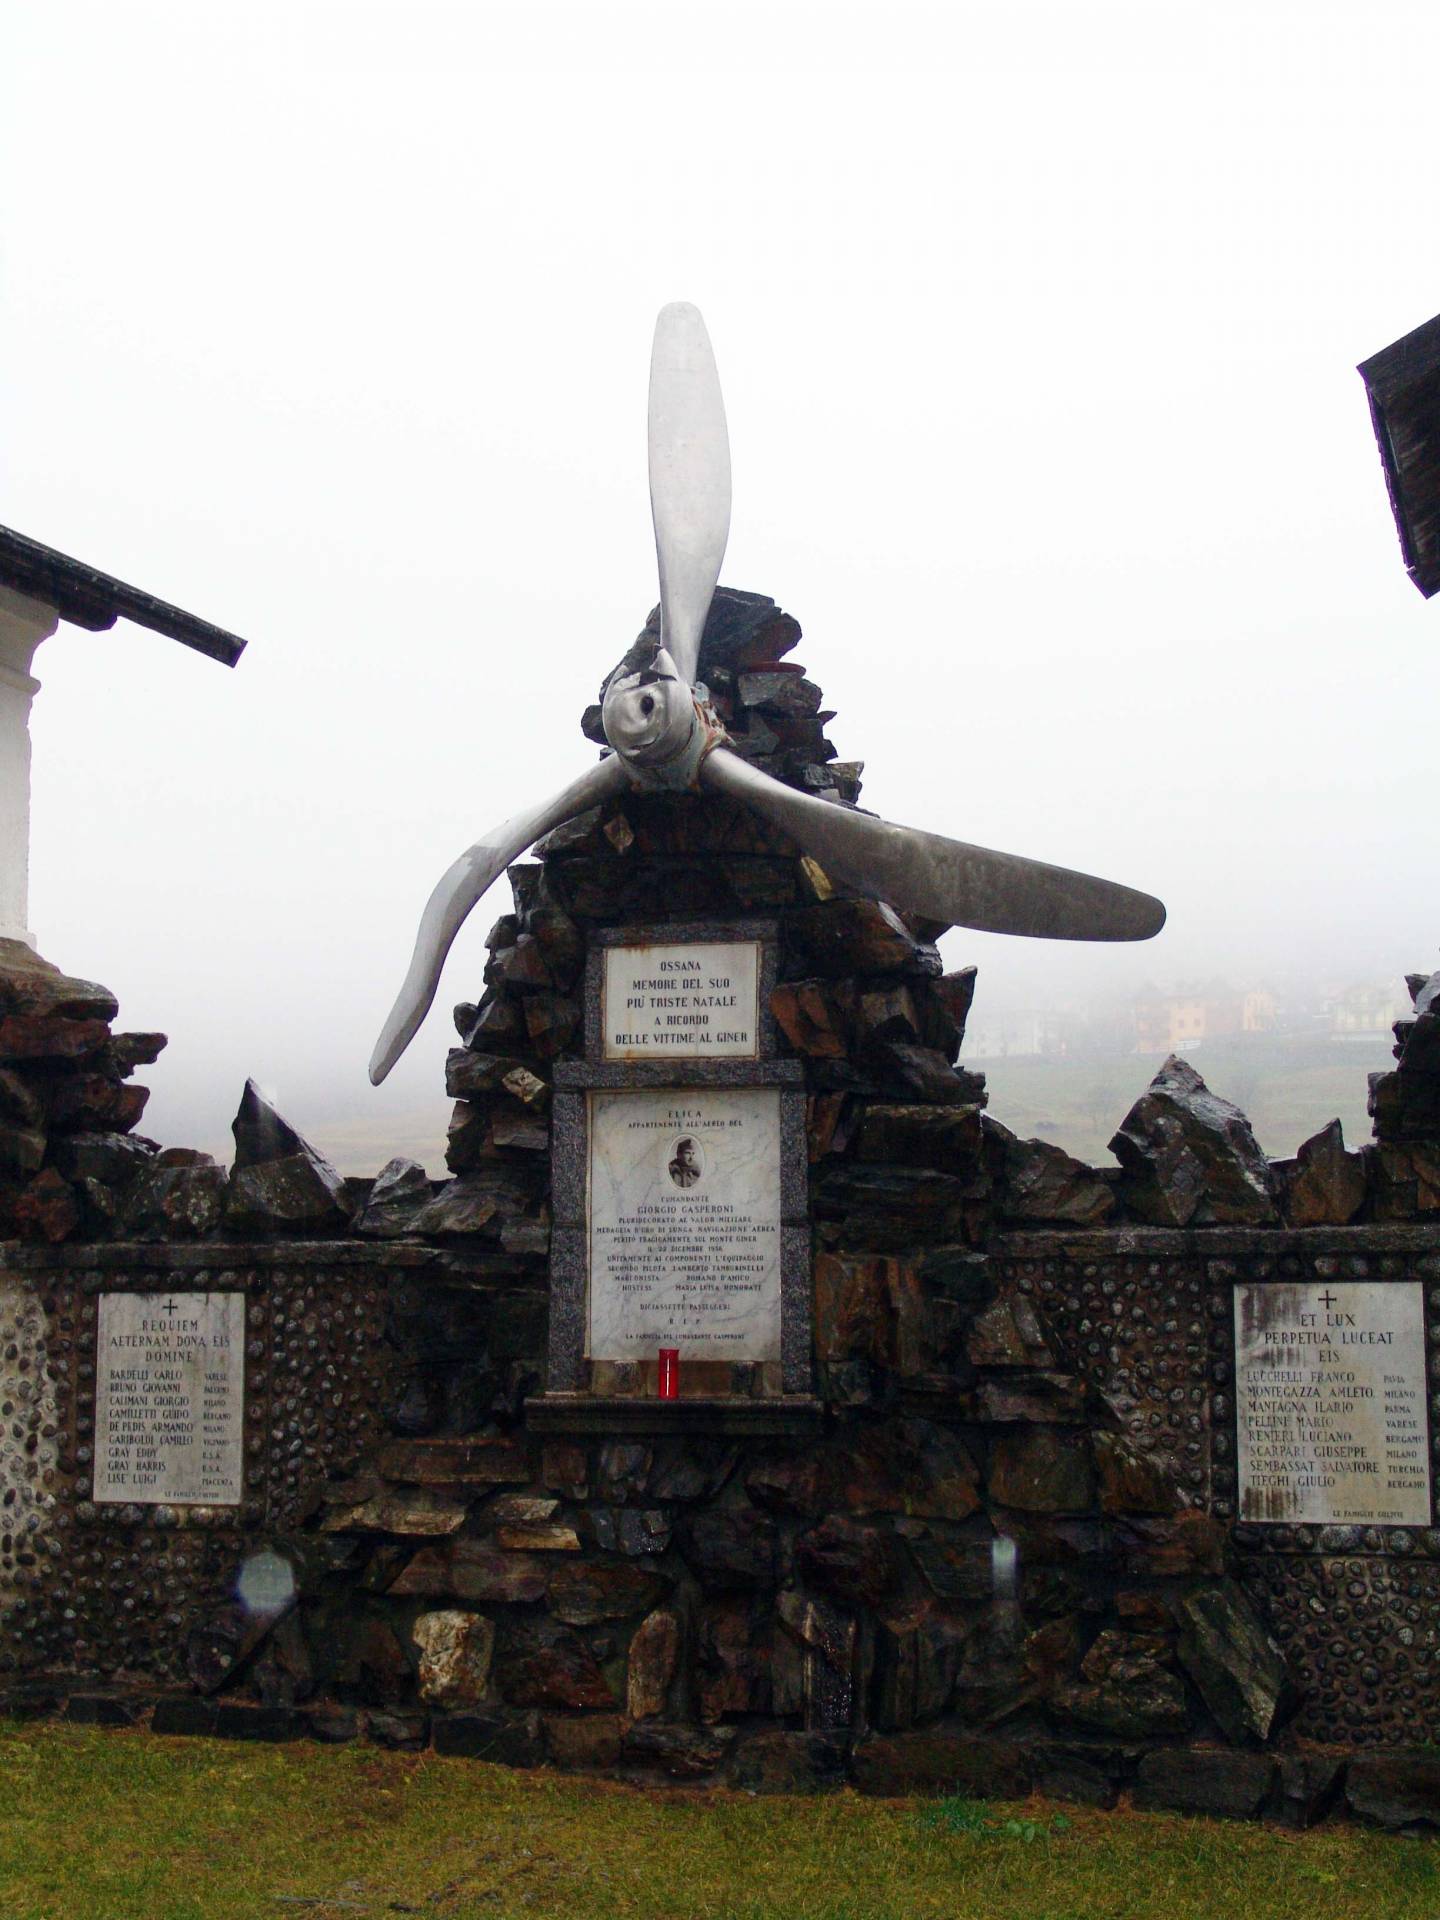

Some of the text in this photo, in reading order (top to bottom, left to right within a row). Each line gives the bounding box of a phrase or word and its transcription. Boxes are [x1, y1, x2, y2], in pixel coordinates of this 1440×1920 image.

[660, 961, 701, 972] OSSANA
[632, 978, 730, 990] MEMORE DEL SUO
[627, 996, 737, 1008] PIÙ TRISTE NATALE
[654, 1015, 709, 1025] A RICORDO
[615, 1032, 747, 1044] DELLE VITTIME AL GINER
[637, 1206, 676, 1214] GIORGIO
[1301, 1314, 1355, 1326] ET LUX
[142, 1320, 199, 1331] REQUIEM
[110, 1336, 230, 1348] AETERNAM DONA EIS
[1265, 1332, 1394, 1344] PERPETUA LUCEAT
[146, 1351, 193, 1362] DOMINE
[1319, 1351, 1340, 1362] EIS
[110, 1370, 182, 1380] BARDELLI CARLO
[1247, 1371, 1355, 1383] LUCCHELLI FRANCO
[1384, 1375, 1405, 1383] PAVIA
[110, 1383, 181, 1393] BRUNO GIOVANNI
[1247, 1386, 1320, 1398] MONTEGAZZA
[1384, 1390, 1415, 1398] MILANO
[110, 1396, 190, 1406] CALIMANI GIORGIO
[1248, 1401, 1354, 1413] MANTAGNA ILARIO
[1385, 1405, 1411, 1413] PARMA
[109, 1409, 189, 1419] CAMILLETTI GUIDO
[109, 1422, 119, 1432] DE
[152, 1423, 194, 1432] ARMANDO
[1248, 1416, 1334, 1428] PELLINI MARIO
[1386, 1420, 1418, 1428] VARESE
[109, 1435, 193, 1445] GARIBOLDI CAMILLO
[1302, 1432, 1352, 1442] LUCIANO
[1386, 1435, 1425, 1444] BERGAMO
[109, 1448, 158, 1458] GRAY EDDY
[1250, 1447, 1367, 1458] SCARPARI GIUSEPPE
[1386, 1451, 1417, 1459] MILANO
[108, 1461, 166, 1471] GRAY HARRIS
[1250, 1462, 1379, 1473] SEMBASSAT SALVATORE
[1387, 1465, 1425, 1474] TURCHIA
[133, 1474, 157, 1484] LUIGI
[1250, 1476, 1335, 1487] TIEGHI GIULIO
[1387, 1481, 1425, 1489] BERGAMO
